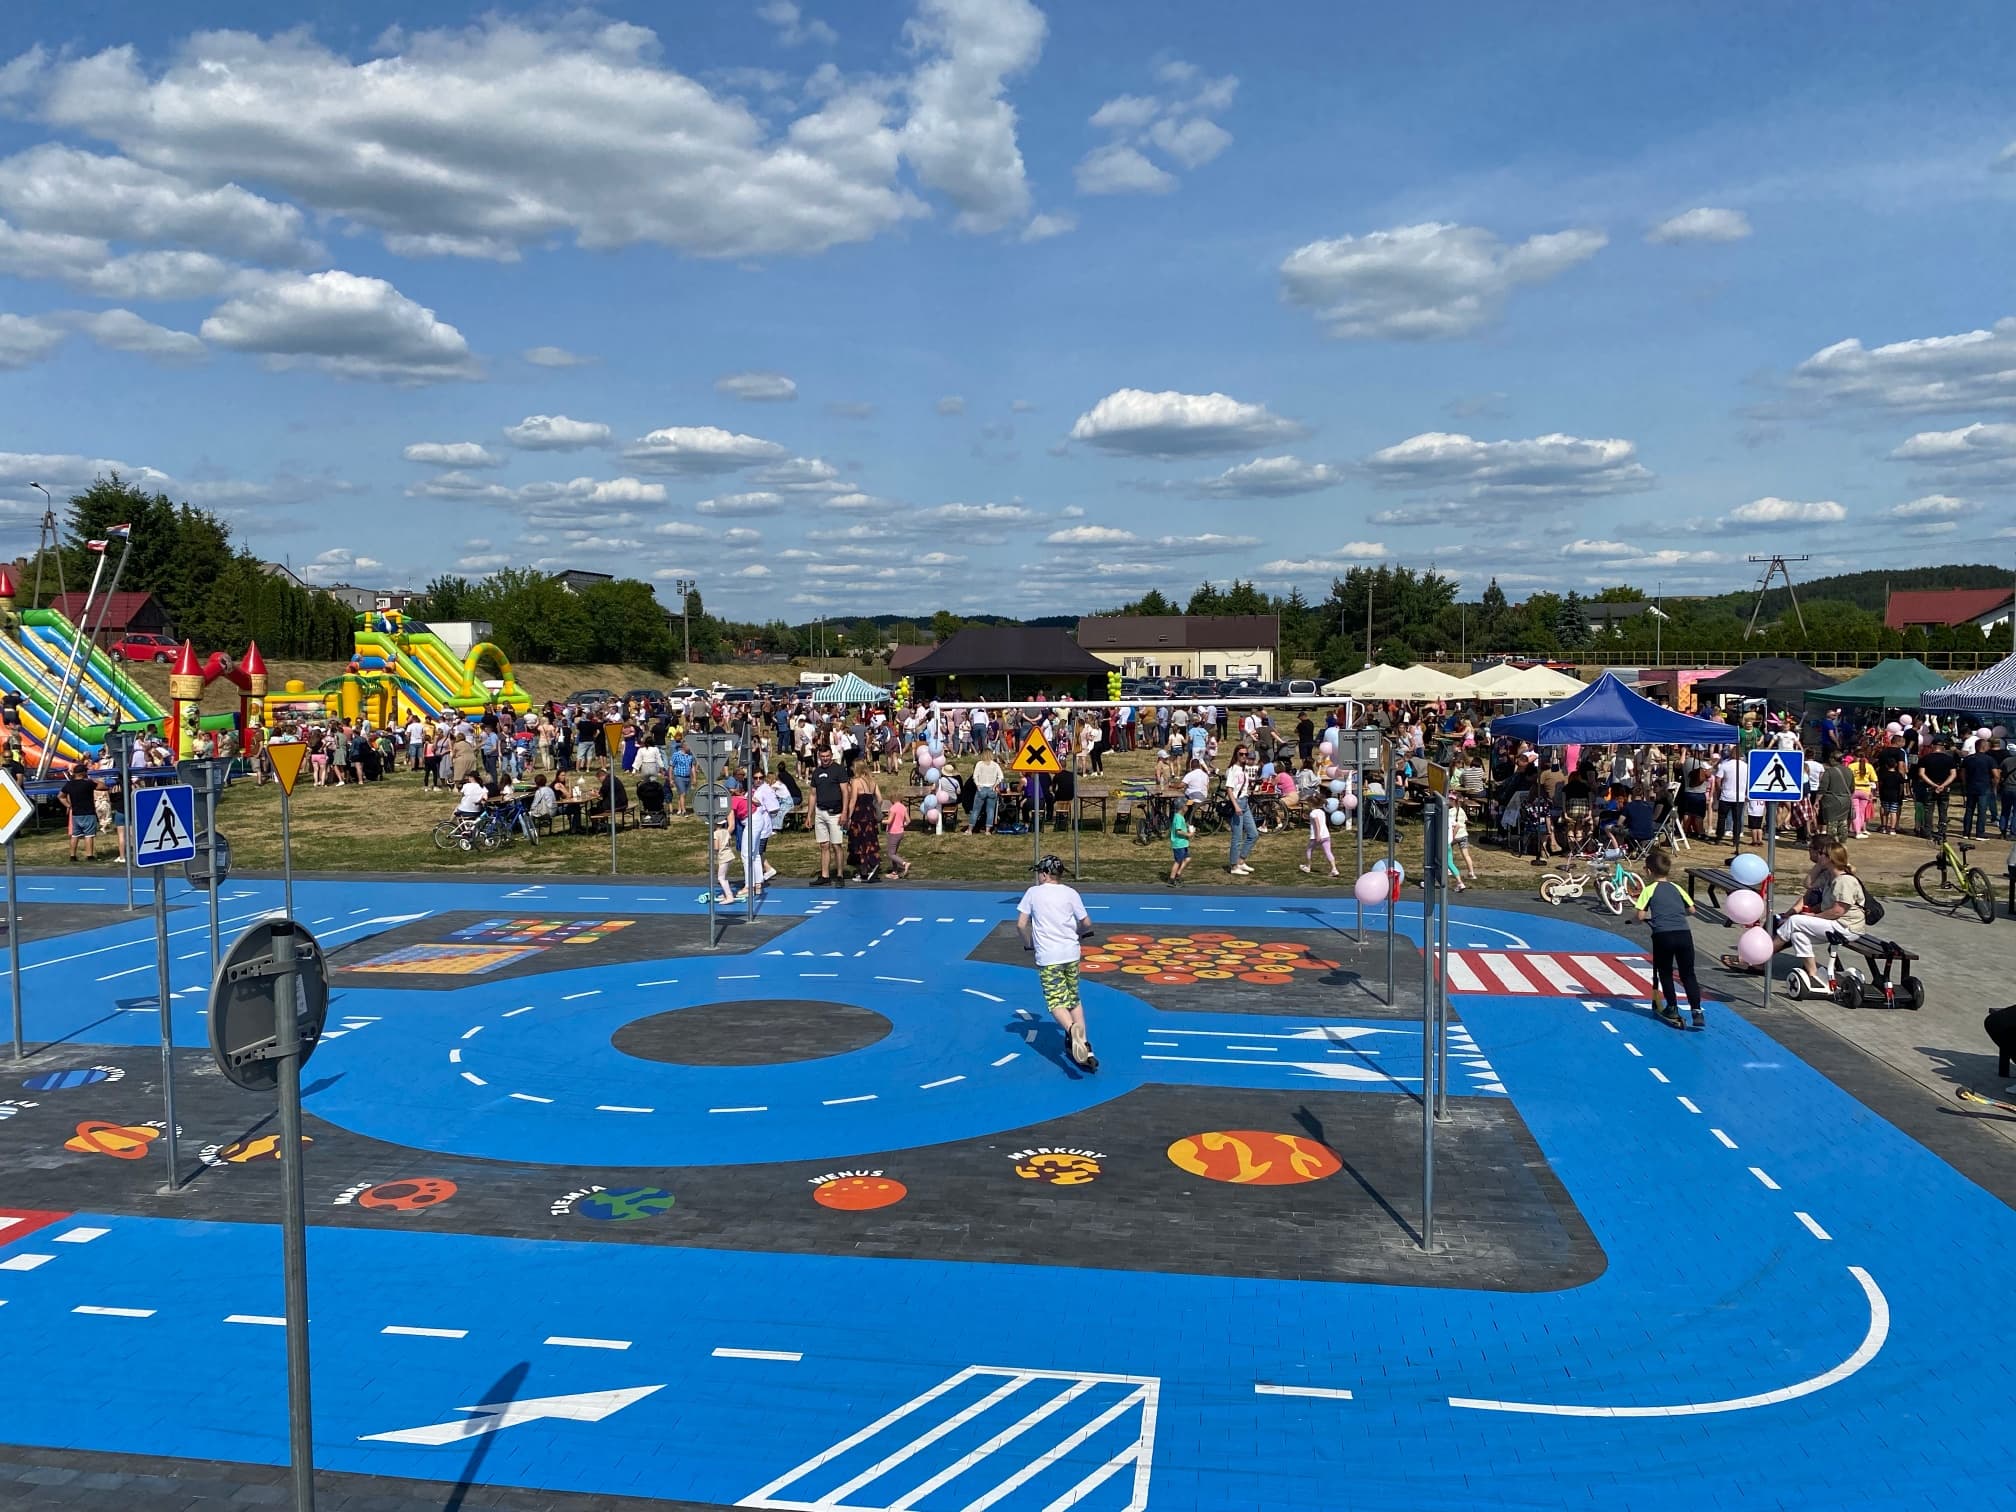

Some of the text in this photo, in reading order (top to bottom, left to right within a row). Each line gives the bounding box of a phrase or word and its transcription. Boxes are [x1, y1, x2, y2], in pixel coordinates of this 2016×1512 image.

[1007, 1147, 1107, 1160] MERKURY
[807, 1169, 884, 1185] WENUS
[333, 1182, 372, 1205] MARS
[550, 1185, 608, 1216] ZIEMIA
